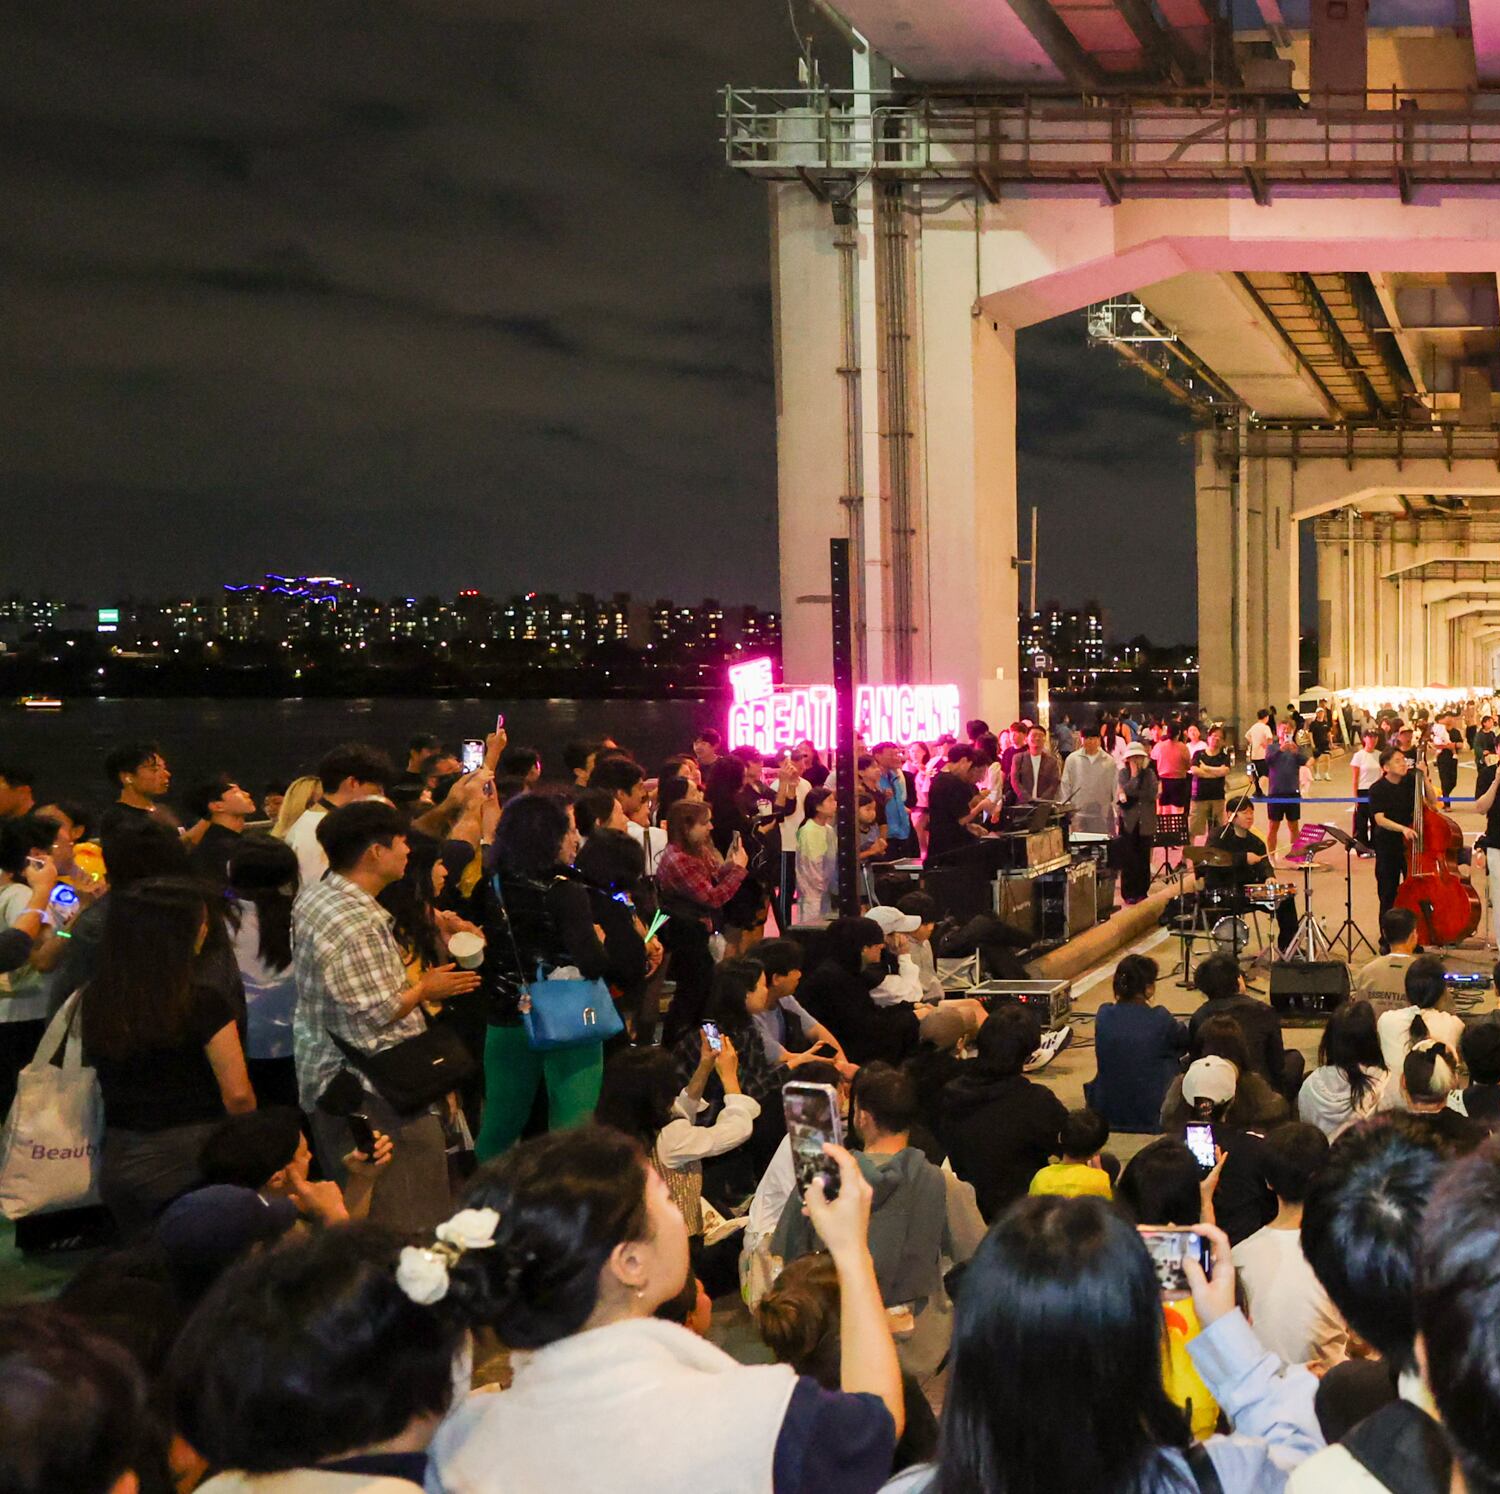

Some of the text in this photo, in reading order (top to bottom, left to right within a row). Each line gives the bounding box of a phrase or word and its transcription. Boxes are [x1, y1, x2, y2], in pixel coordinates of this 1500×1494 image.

[729, 684, 960, 755] GREAT ANGANG
[1368, 991, 1407, 1001] ESSENTIA
